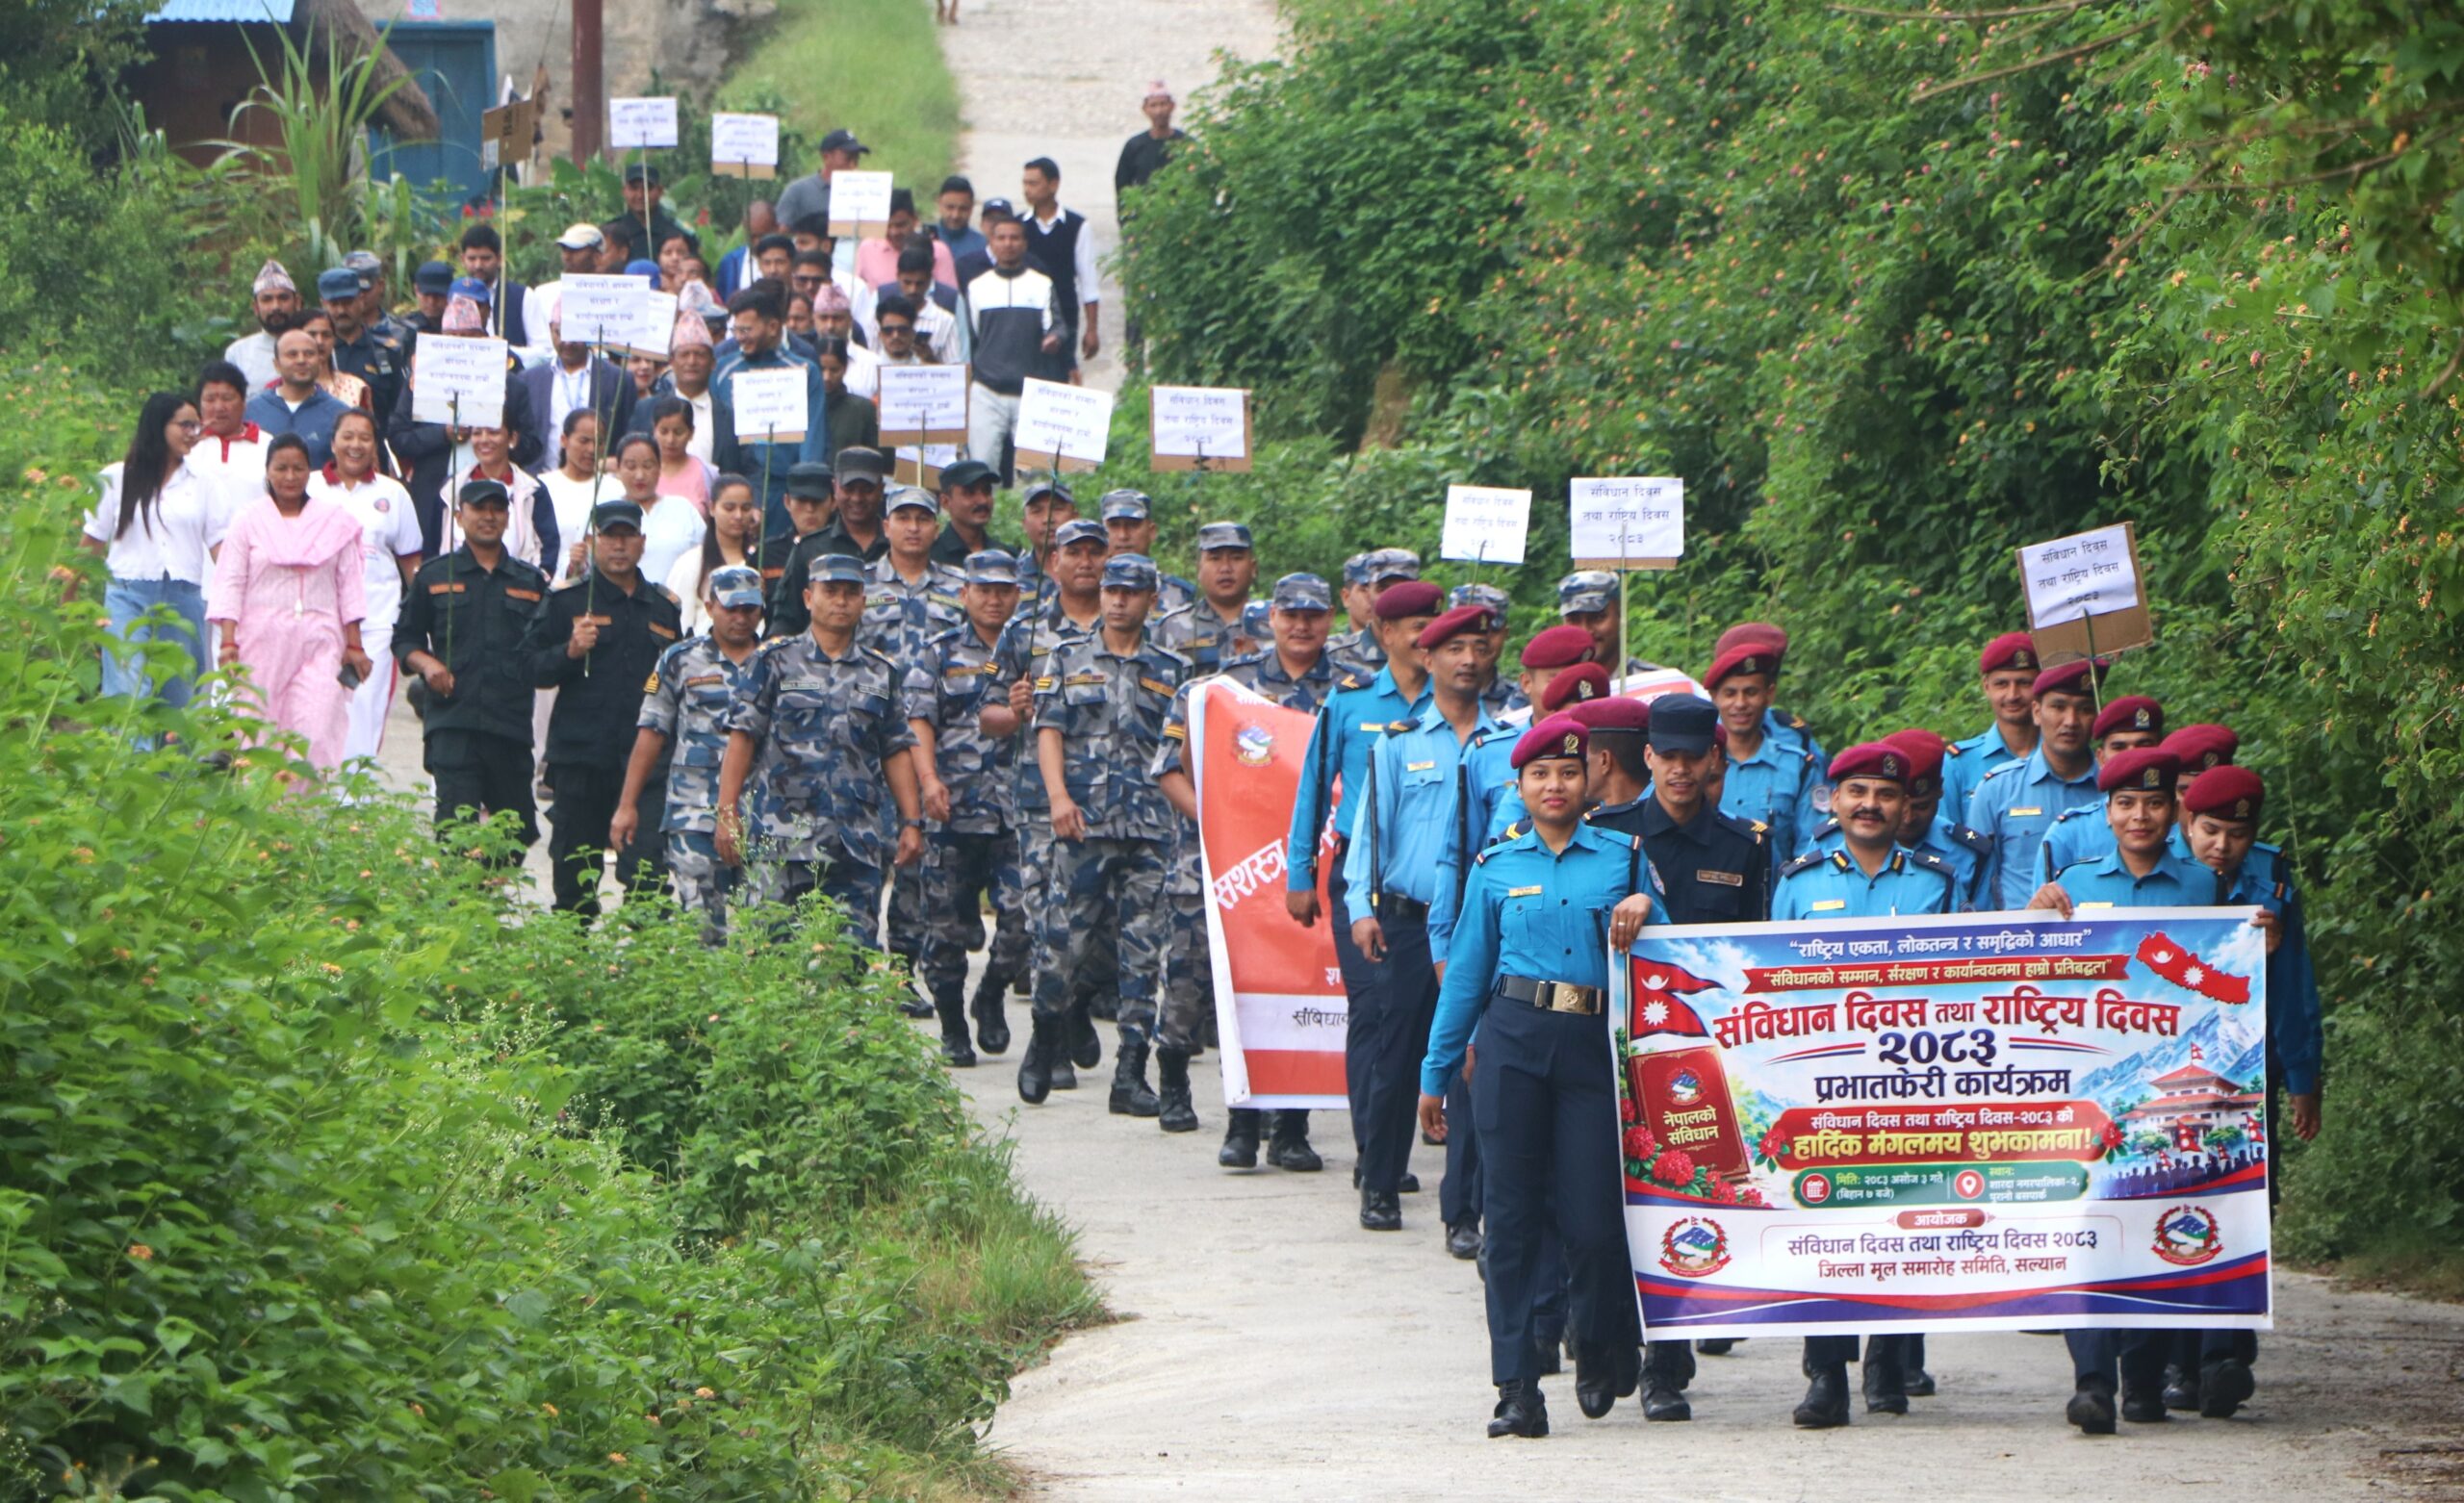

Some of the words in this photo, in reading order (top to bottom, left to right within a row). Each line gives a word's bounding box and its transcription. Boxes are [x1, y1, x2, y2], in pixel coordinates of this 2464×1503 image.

[1848, 939, 1893, 956] एकता,
[1897, 934, 1960, 954] लोकतन्त्र
[1963, 936, 1972, 951] र
[2039, 928, 2092, 948] आधार”
[1837, 969, 1884, 984] सम्मान,
[1932, 966, 1941, 980] र
[1943, 960, 2021, 980] कार्यान्वयनमा
[2024, 958, 2050, 978] हाम्रो
[1713, 1001, 1837, 1049] संविधान
[1845, 990, 1929, 1033] दिवस
[1935, 1002, 1976, 1023] तथा
[1982, 984, 2088, 1035] राष्ट्रिय
[2095, 987, 2182, 1036] दिवस
[1878, 1029, 1997, 1067] २०८३
[1814, 1065, 1947, 1103] प्रभातफेरी
[1954, 1063, 2071, 1097] कार्यक्रम
[1662, 1104, 1717, 1127] नेपालको
[1810, 1111, 1863, 1130] संविधान
[1865, 1110, 1901, 1129] दिवस
[1905, 1112, 1931, 1127] तथा
[1934, 1108, 1976, 1129] राष्ट्रिय
[2056, 1106, 2074, 1123] को
[1667, 1125, 1719, 1146] संविधान
[1792, 1129, 1863, 1160] हार्दिक
[1866, 1129, 1964, 1156] मंगलमय
[1967, 1127, 2092, 1160] शुभकामना!
[1913, 1210, 1968, 1226] आयोजक
[1787, 1234, 1856, 1256] संविधान
[1861, 1233, 1905, 1255] दिवस
[1909, 1235, 1941, 1253] तथा
[1946, 1229, 2000, 1254] राष्ट्रिय
[2003, 1228, 2047, 1251] दिवस
[2052, 1230, 2098, 1250] २०८३
[1818, 1259, 1864, 1279] जिल्ला
[1870, 1261, 1897, 1282] मूल
[1901, 1256, 1956, 1277] समारोह
[1961, 1254, 2011, 1276] समिति,
[2014, 1256, 2067, 1273] सल्यान
